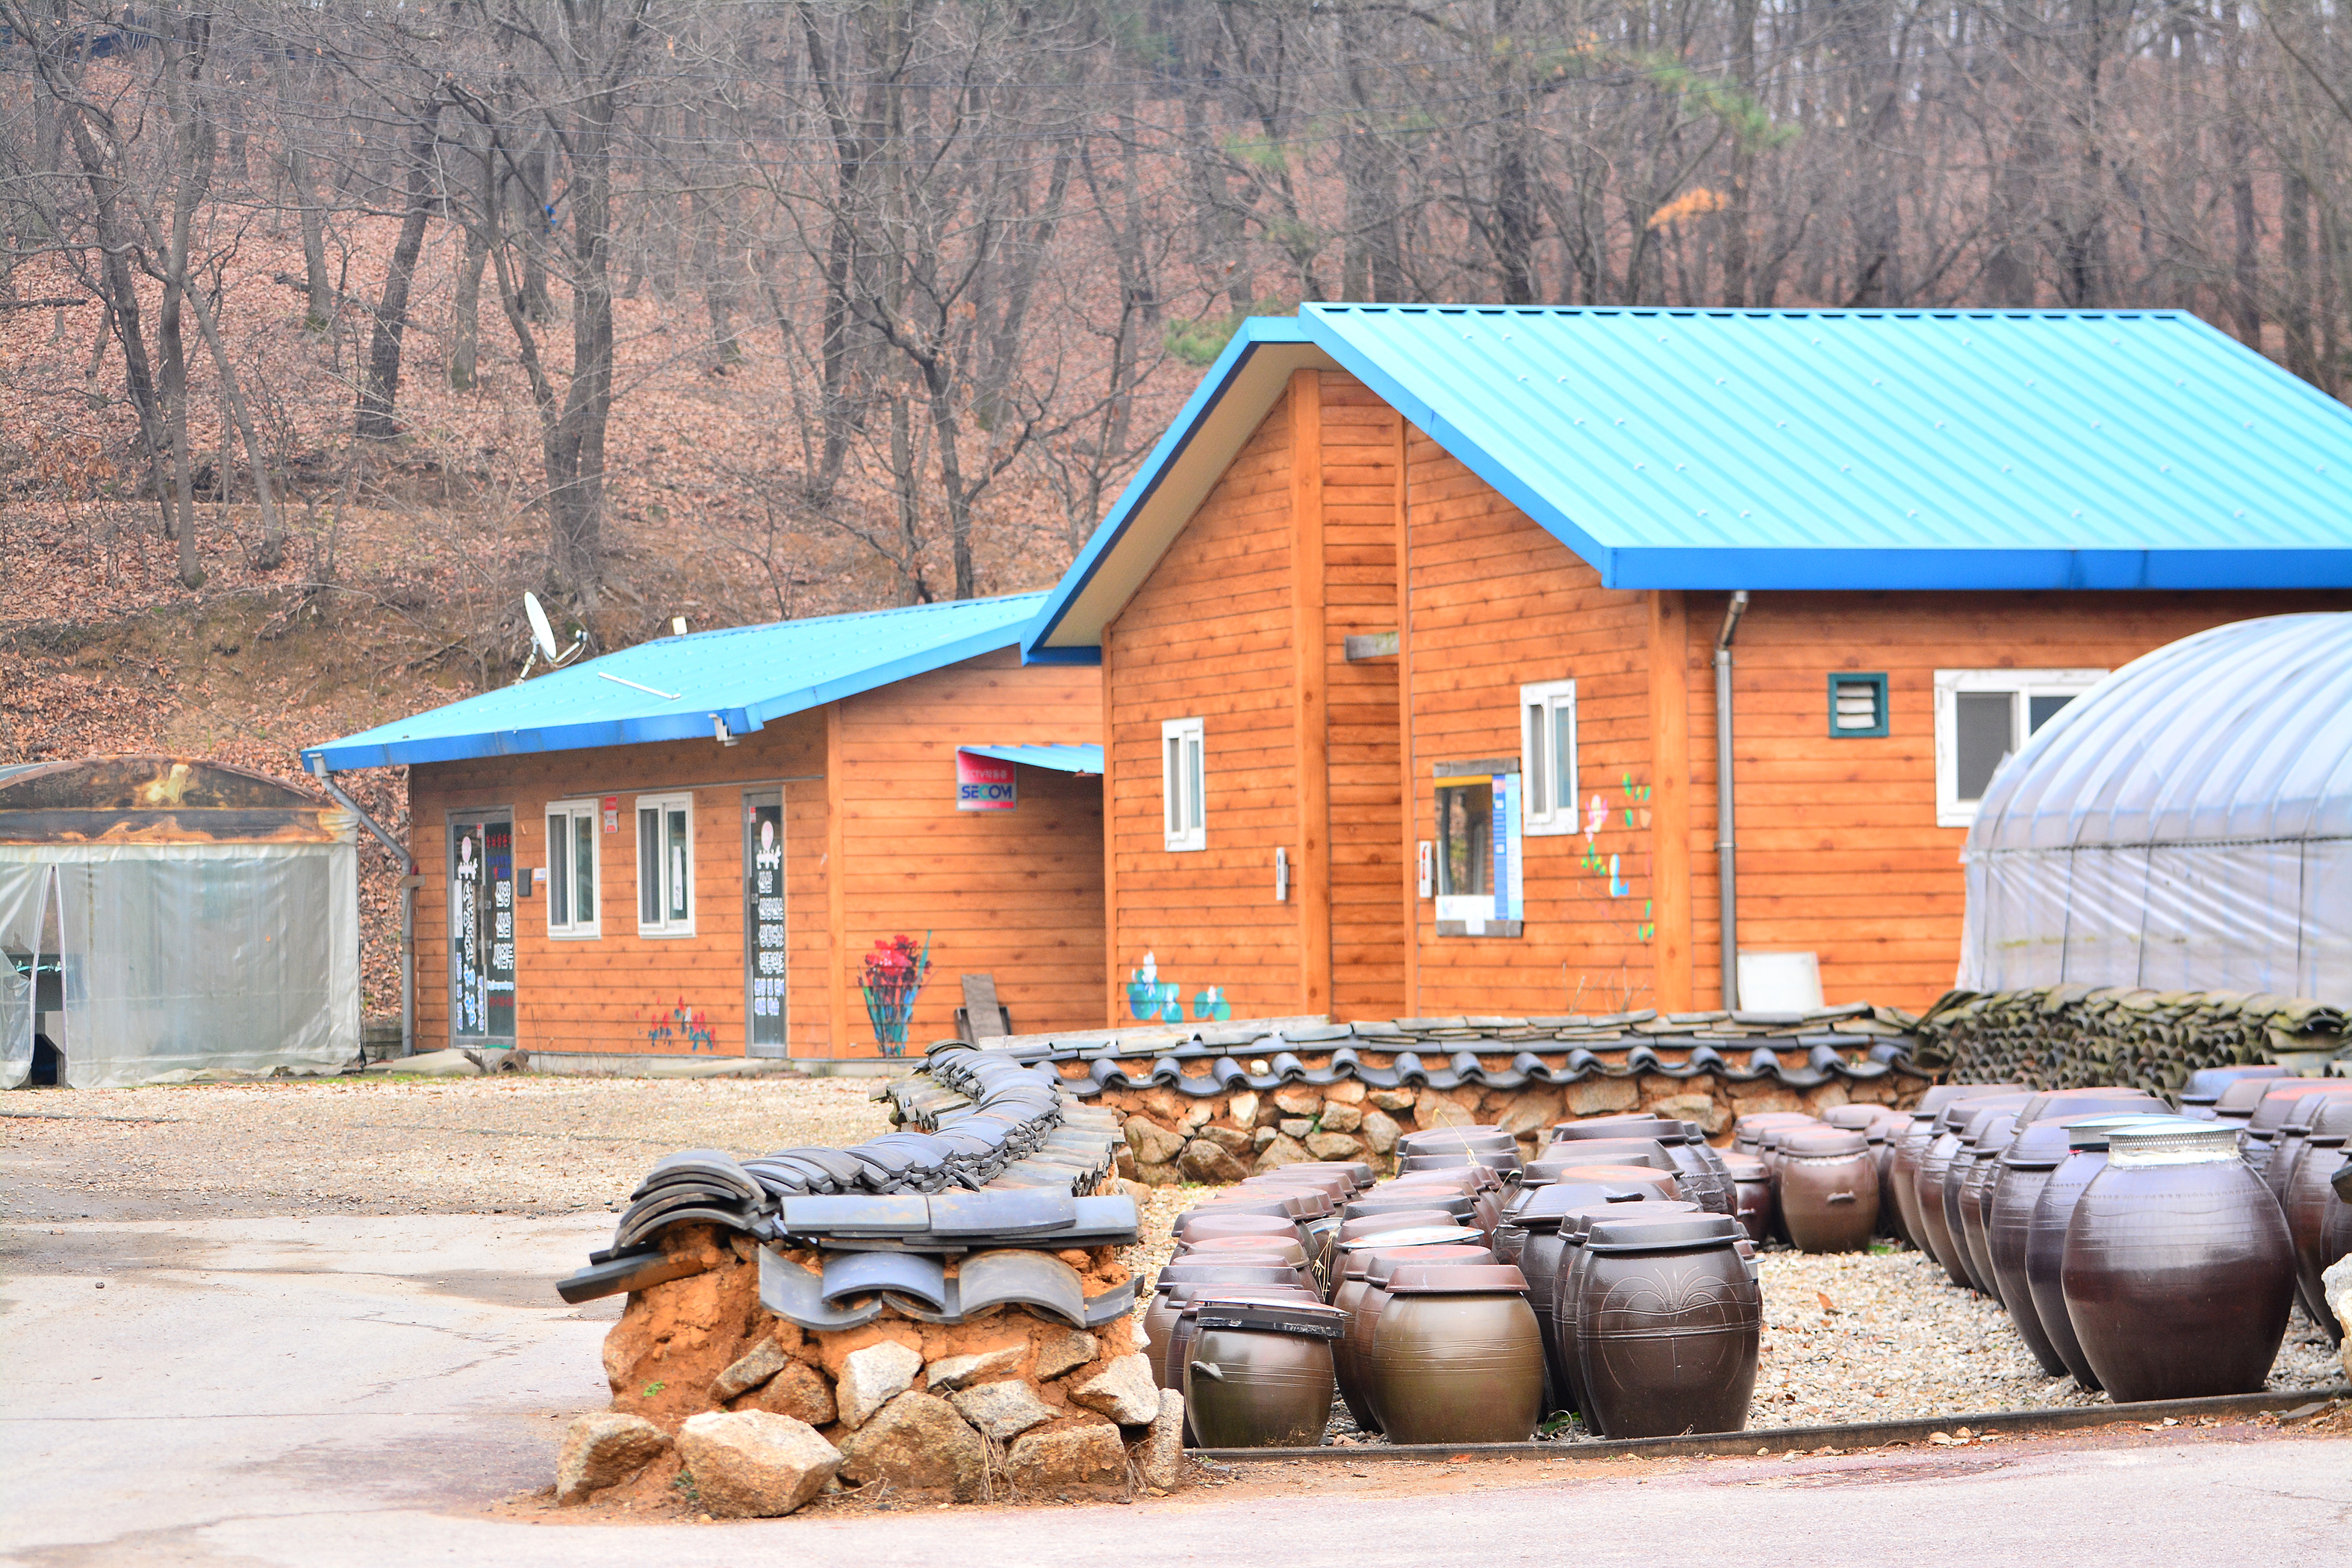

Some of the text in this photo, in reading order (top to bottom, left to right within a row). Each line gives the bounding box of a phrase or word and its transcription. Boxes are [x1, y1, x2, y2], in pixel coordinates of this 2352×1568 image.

[962, 785, 1012, 799] SECOM
[495, 880, 511, 907] 산양
[758, 871, 773, 893] 산삼
[495, 912, 511, 938] 산삼
